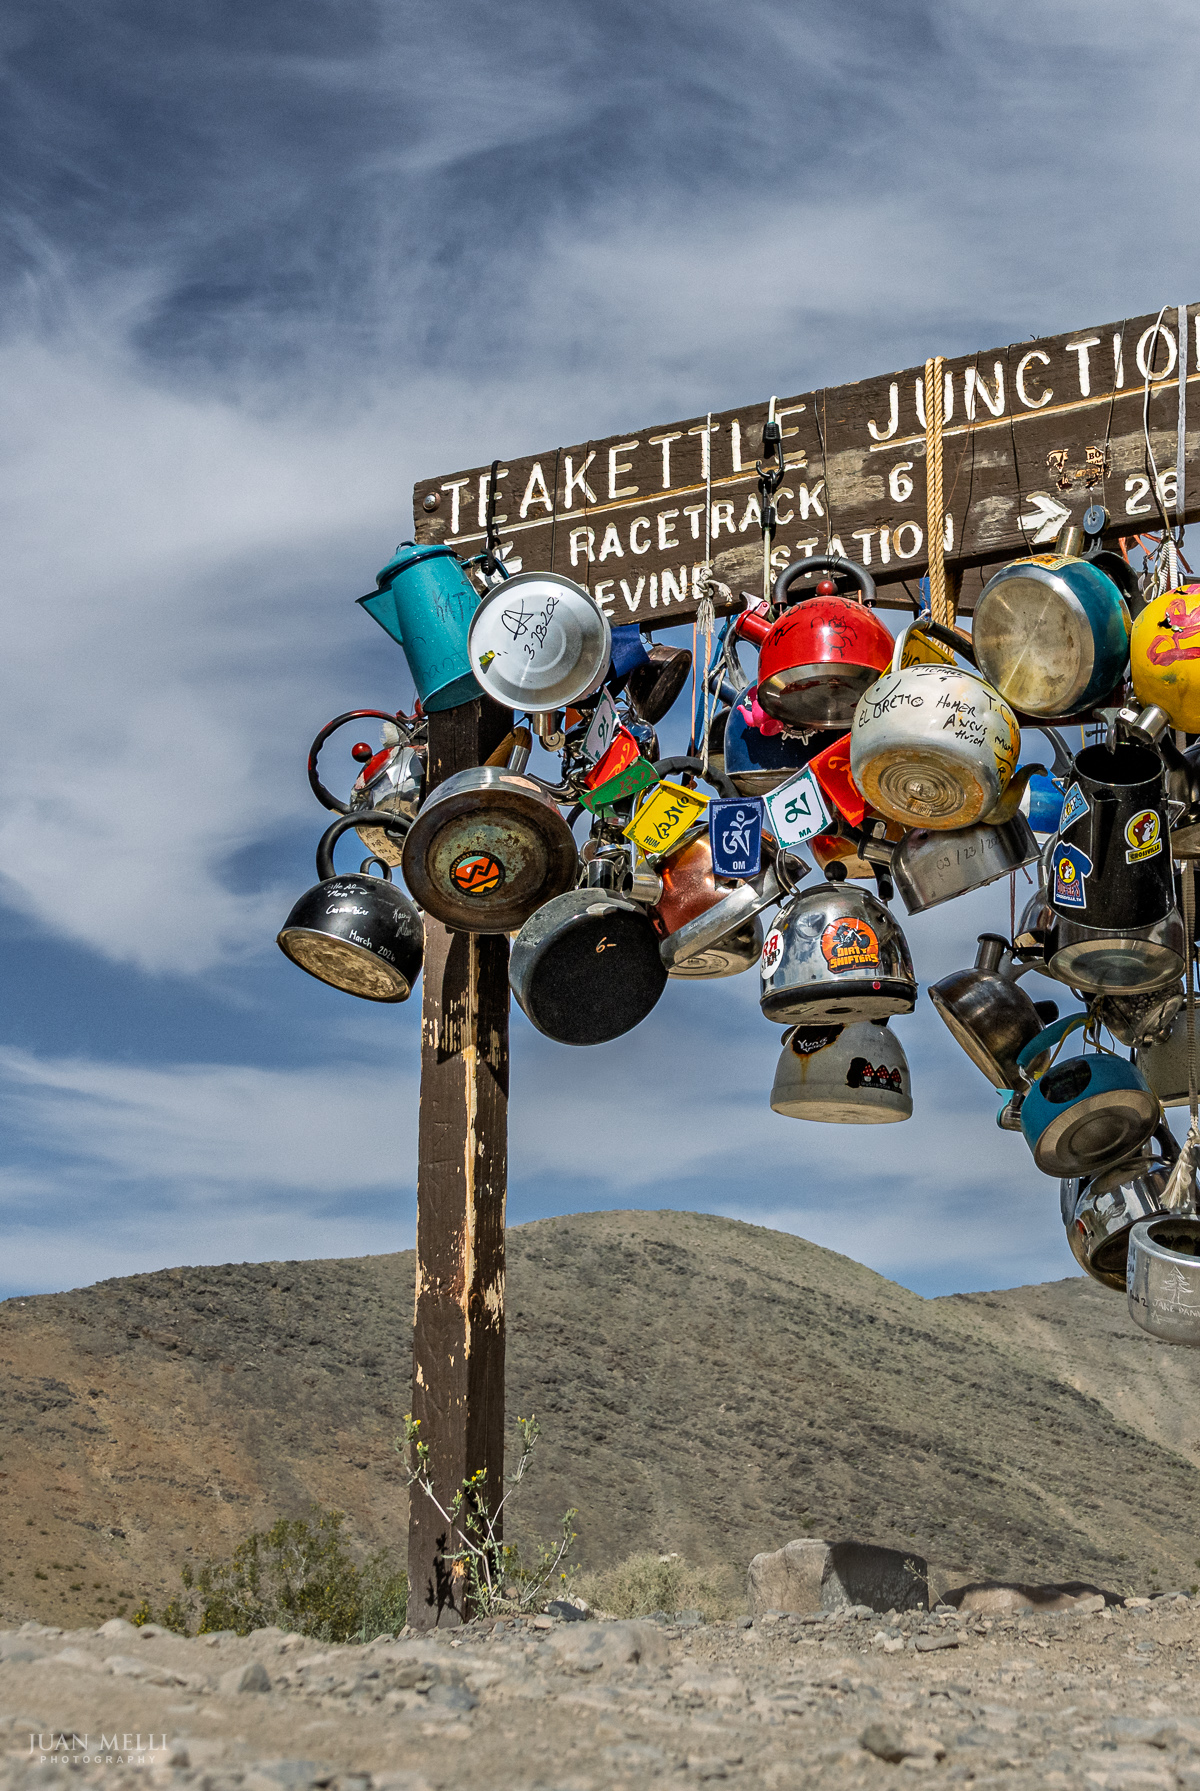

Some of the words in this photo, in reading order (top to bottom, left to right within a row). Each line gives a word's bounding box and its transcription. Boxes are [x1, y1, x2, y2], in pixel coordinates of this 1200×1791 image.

[441, 403, 807, 534] TEAKETTLE
[1125, 467, 1178, 516] 26
[570, 480, 826, 567] RACETRACK
[889, 462, 914, 503] 6
[798, 827, 812, 838] MA
[643, 835, 661, 848] HUM
[732, 860, 746, 870] OM
[349, 929, 373, 949] March
[377, 945, 396, 962] 2026
[837, 946, 867, 957] DIRTY
[830, 953, 879, 969] SHIFTERS
